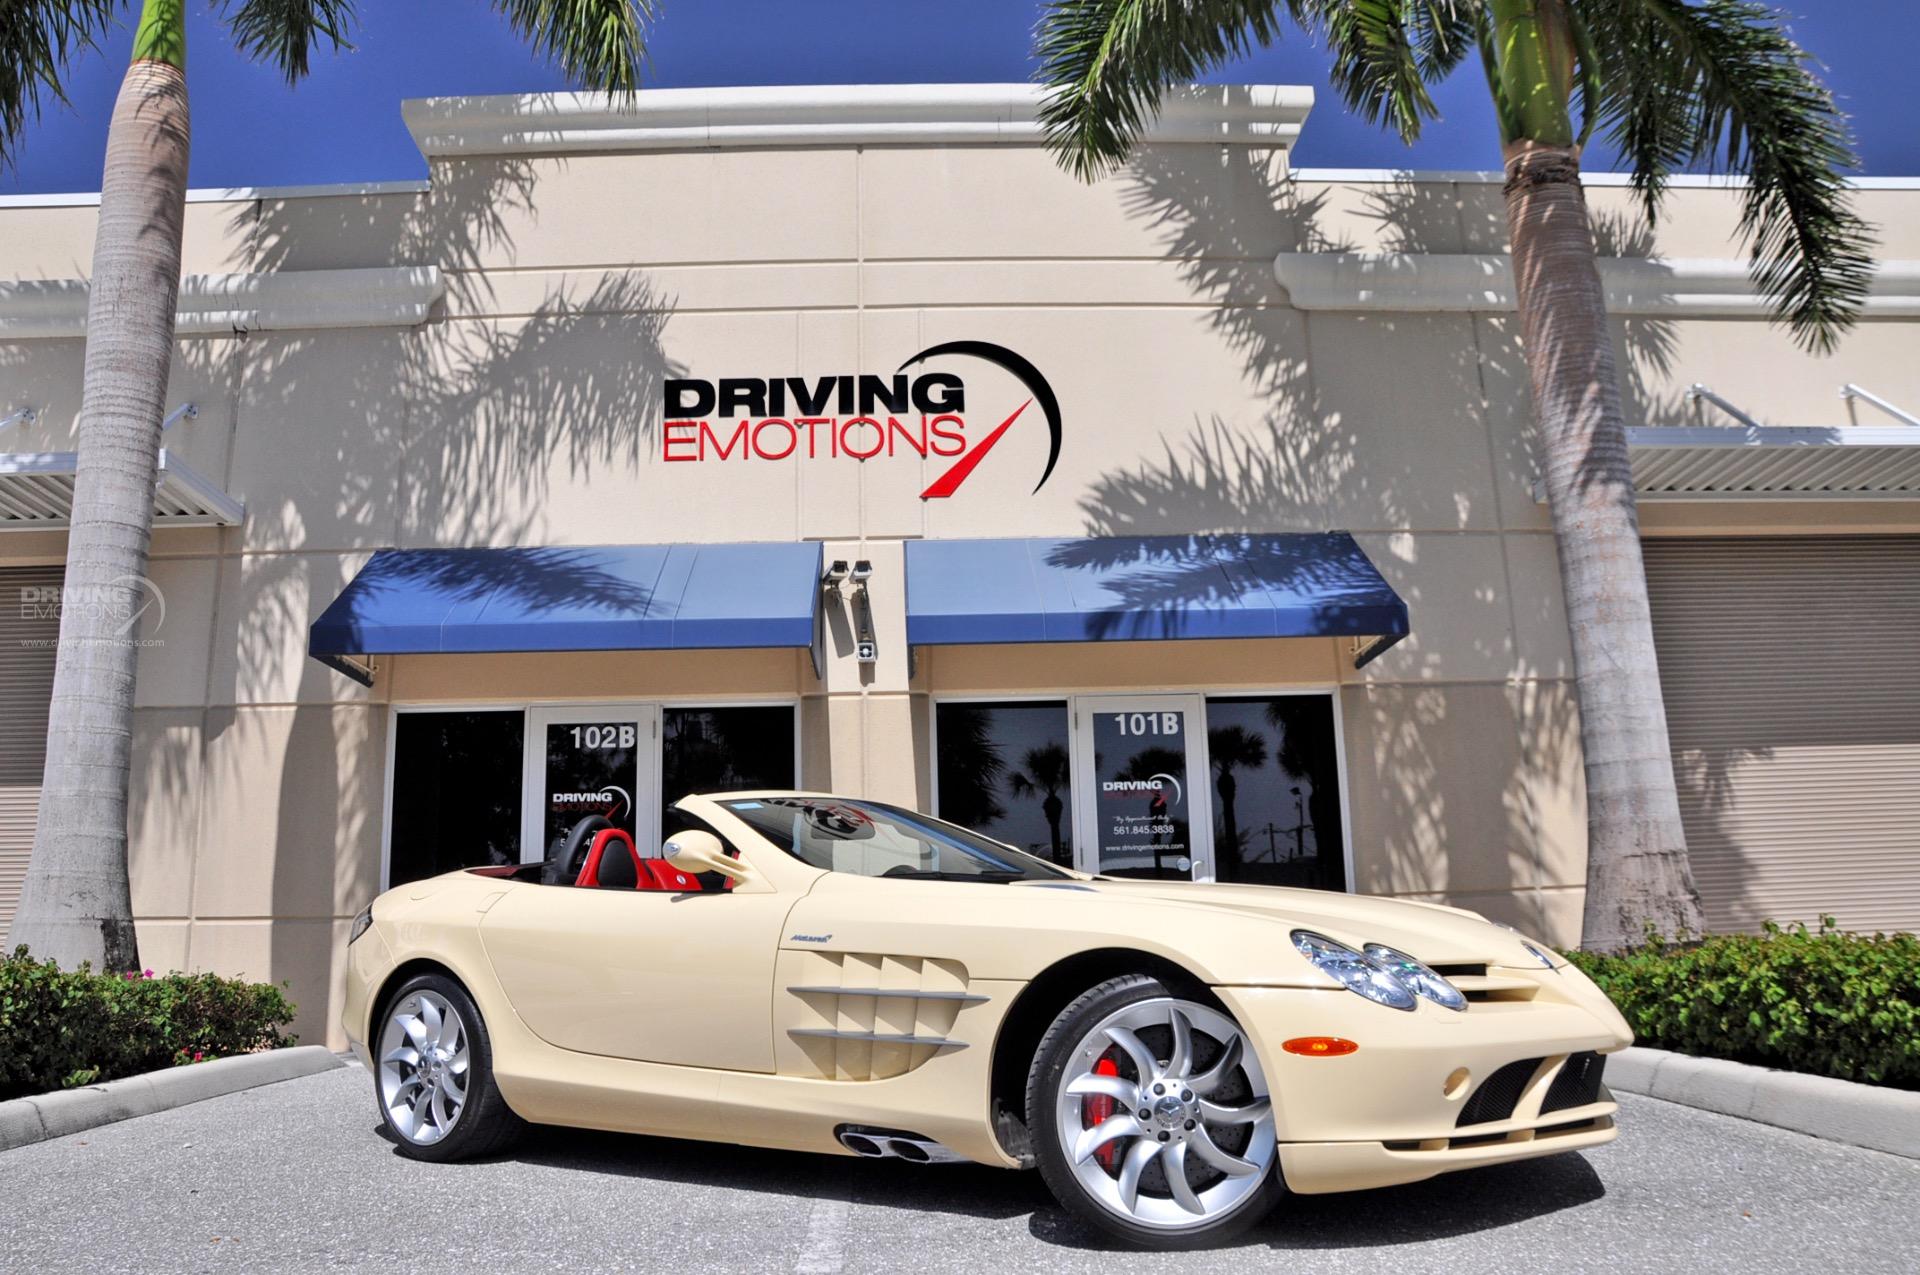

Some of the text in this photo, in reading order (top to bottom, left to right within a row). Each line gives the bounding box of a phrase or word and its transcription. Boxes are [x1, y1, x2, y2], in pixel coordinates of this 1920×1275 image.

[664, 372, 965, 418] DRIVING
[663, 414, 967, 462] EMOTIONS
[1115, 713, 1179, 736] 101B
[570, 726, 635, 749] 102B
[1103, 780, 1163, 791] DRIVING
[552, 792, 613, 803] DRIVING
[1113, 825, 1175, 835] 561.845.3838
[1105, 843, 1184, 851] www.drivingemotions.com
